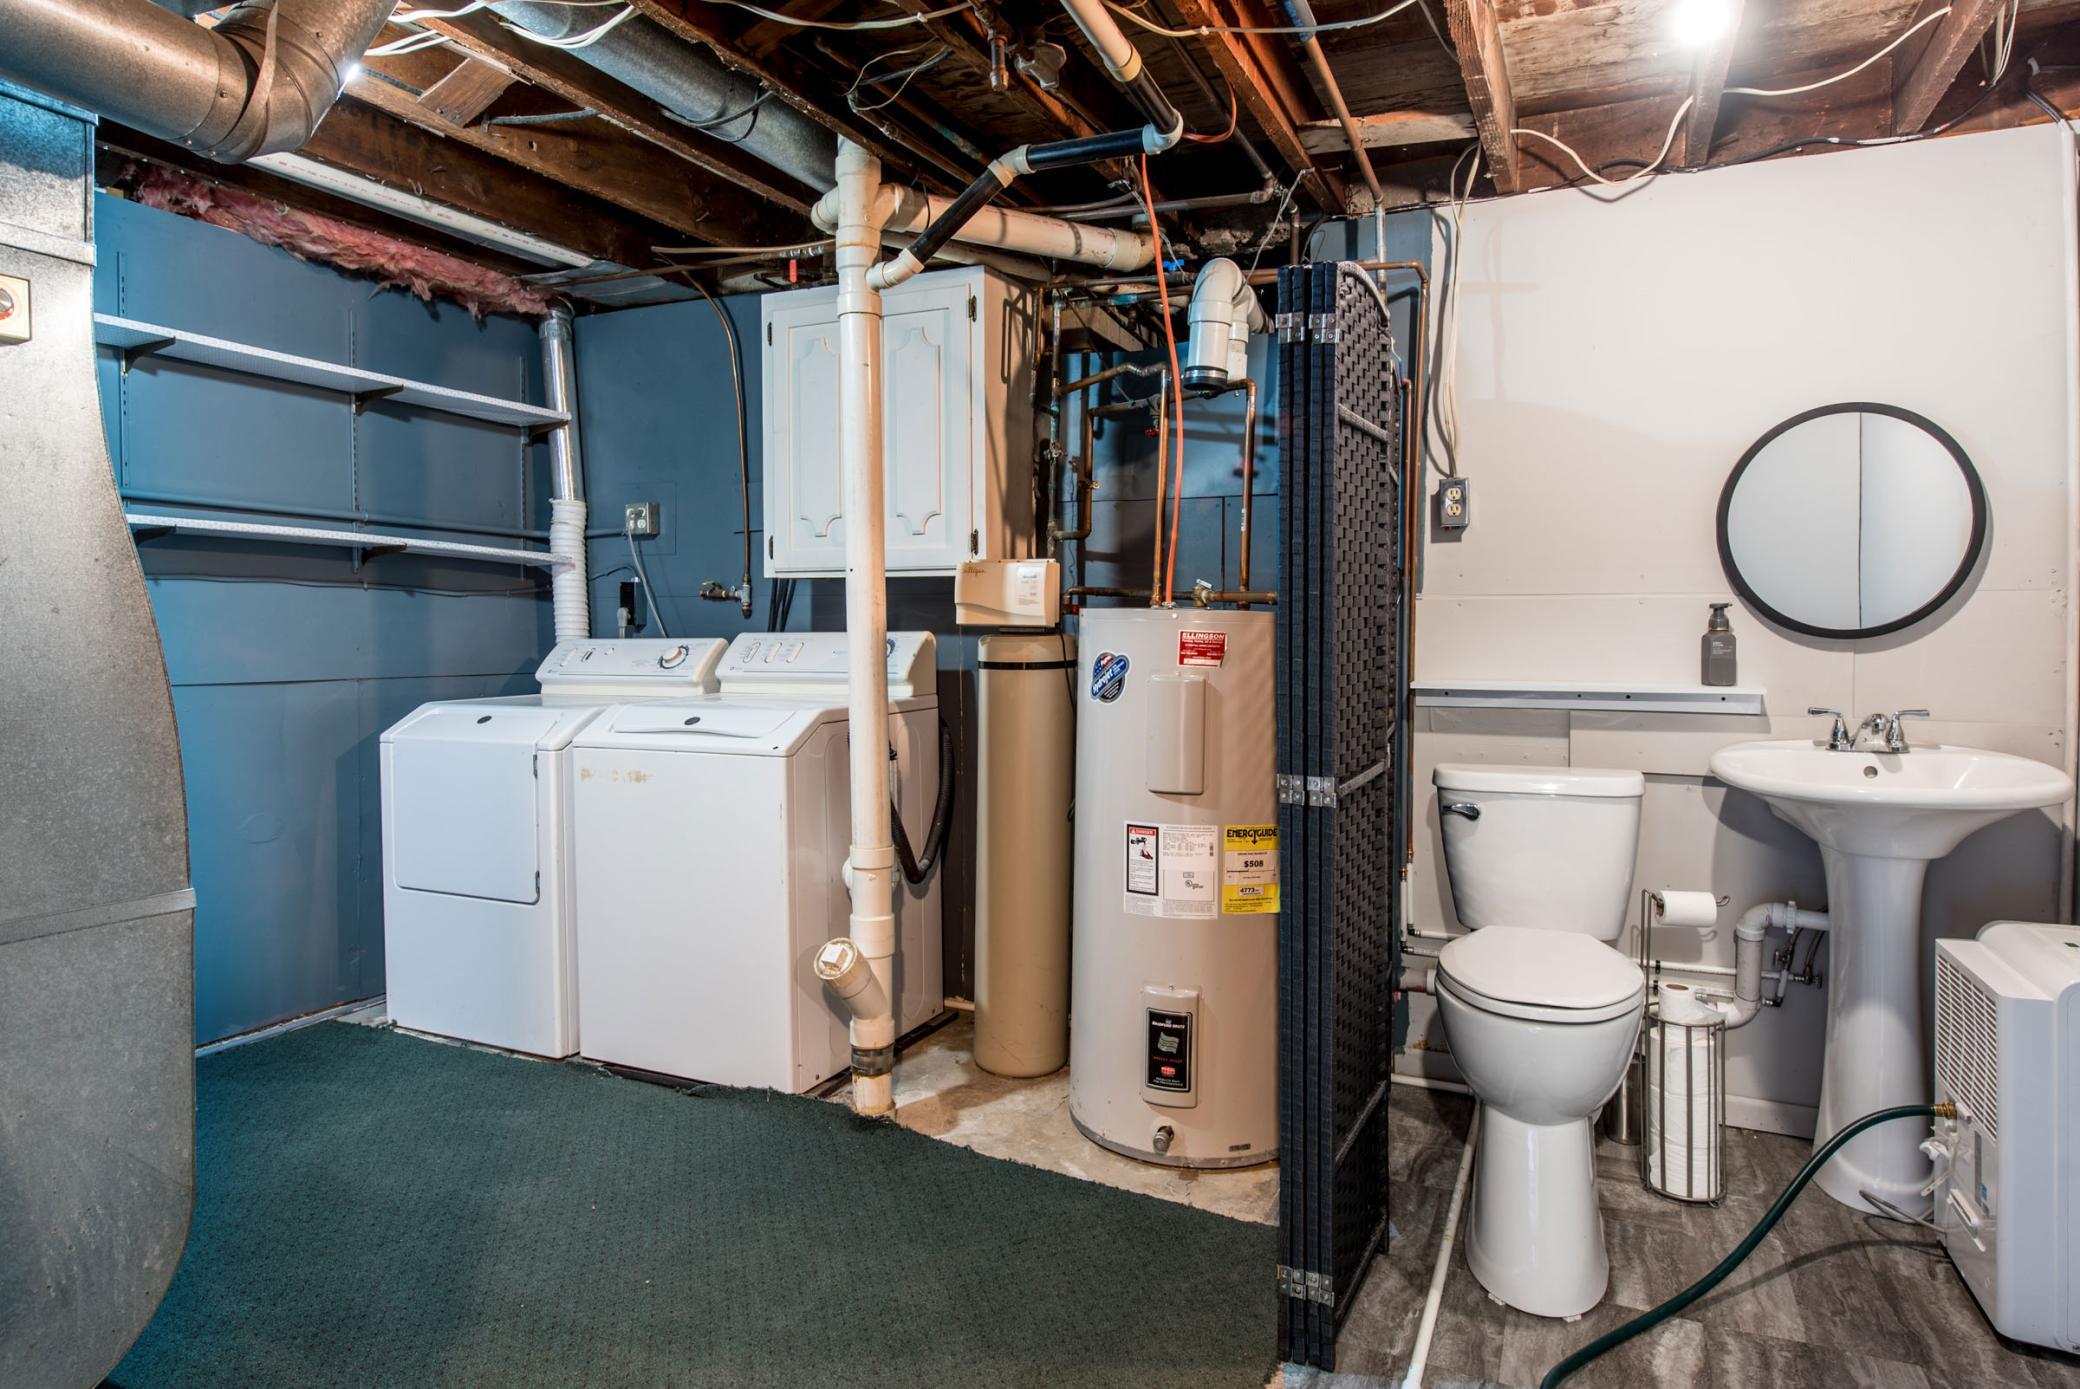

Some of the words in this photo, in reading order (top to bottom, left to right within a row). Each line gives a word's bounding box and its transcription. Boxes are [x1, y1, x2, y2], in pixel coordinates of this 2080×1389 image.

[1182, 632, 1225, 640] ELLINGSON
[1226, 827, 1278, 839] ENERGYGUIDE
[1244, 859, 1264, 868] $508
